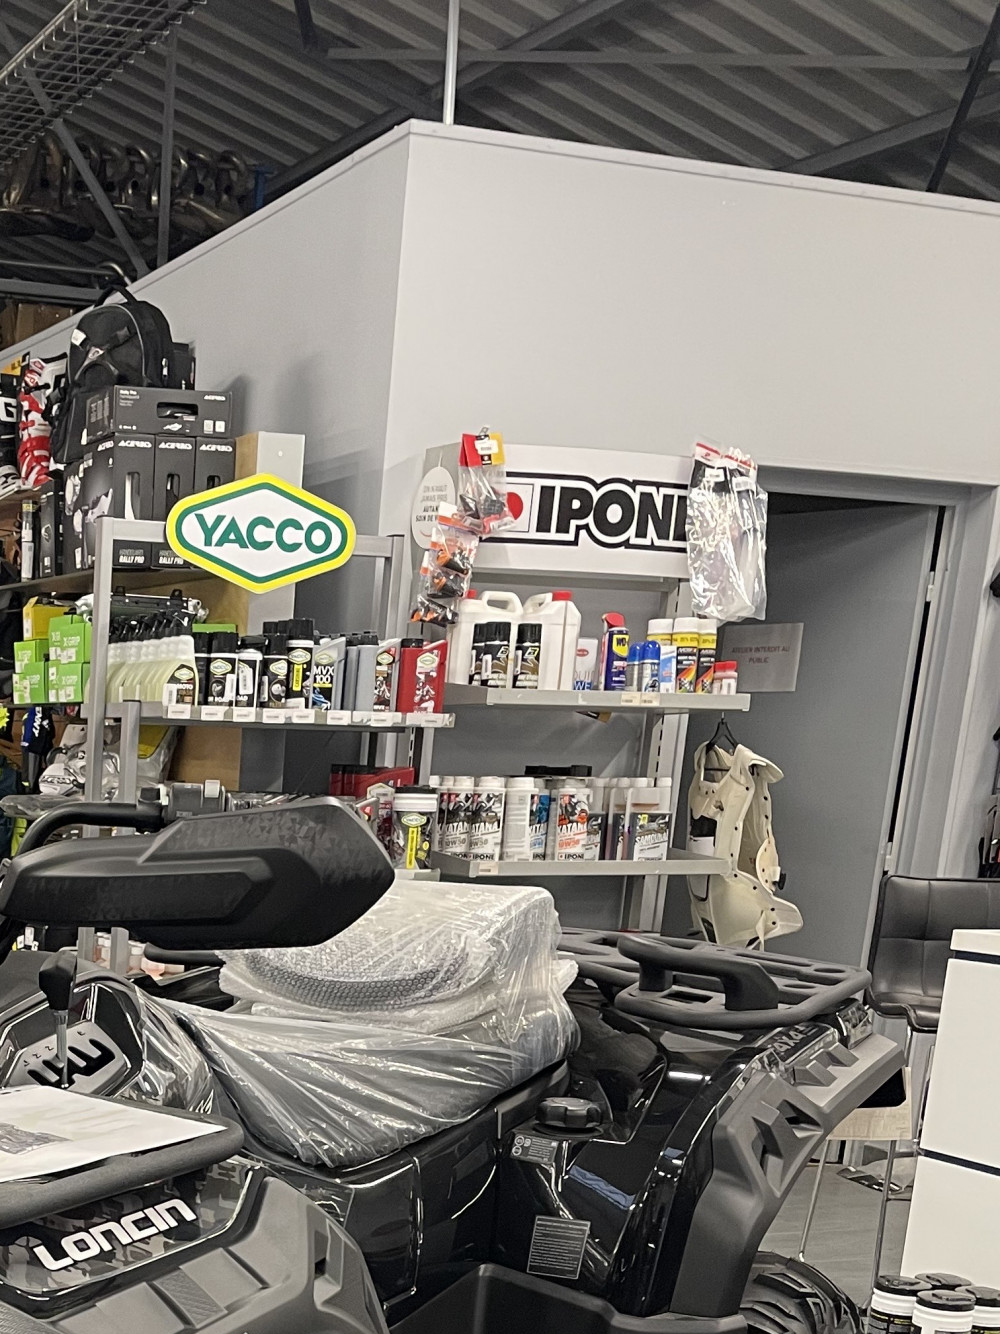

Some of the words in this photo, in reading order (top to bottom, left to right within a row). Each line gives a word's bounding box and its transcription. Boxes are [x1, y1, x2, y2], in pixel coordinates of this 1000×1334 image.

[194, 511, 332, 558] YACCO
[748, 656, 769, 664] PUBLIC
[313, 665, 335, 676] MVX
[315, 675, 331, 684] 100
[470, 820, 499, 834] ATANA
[32, 1197, 197, 1272] LONCIN
